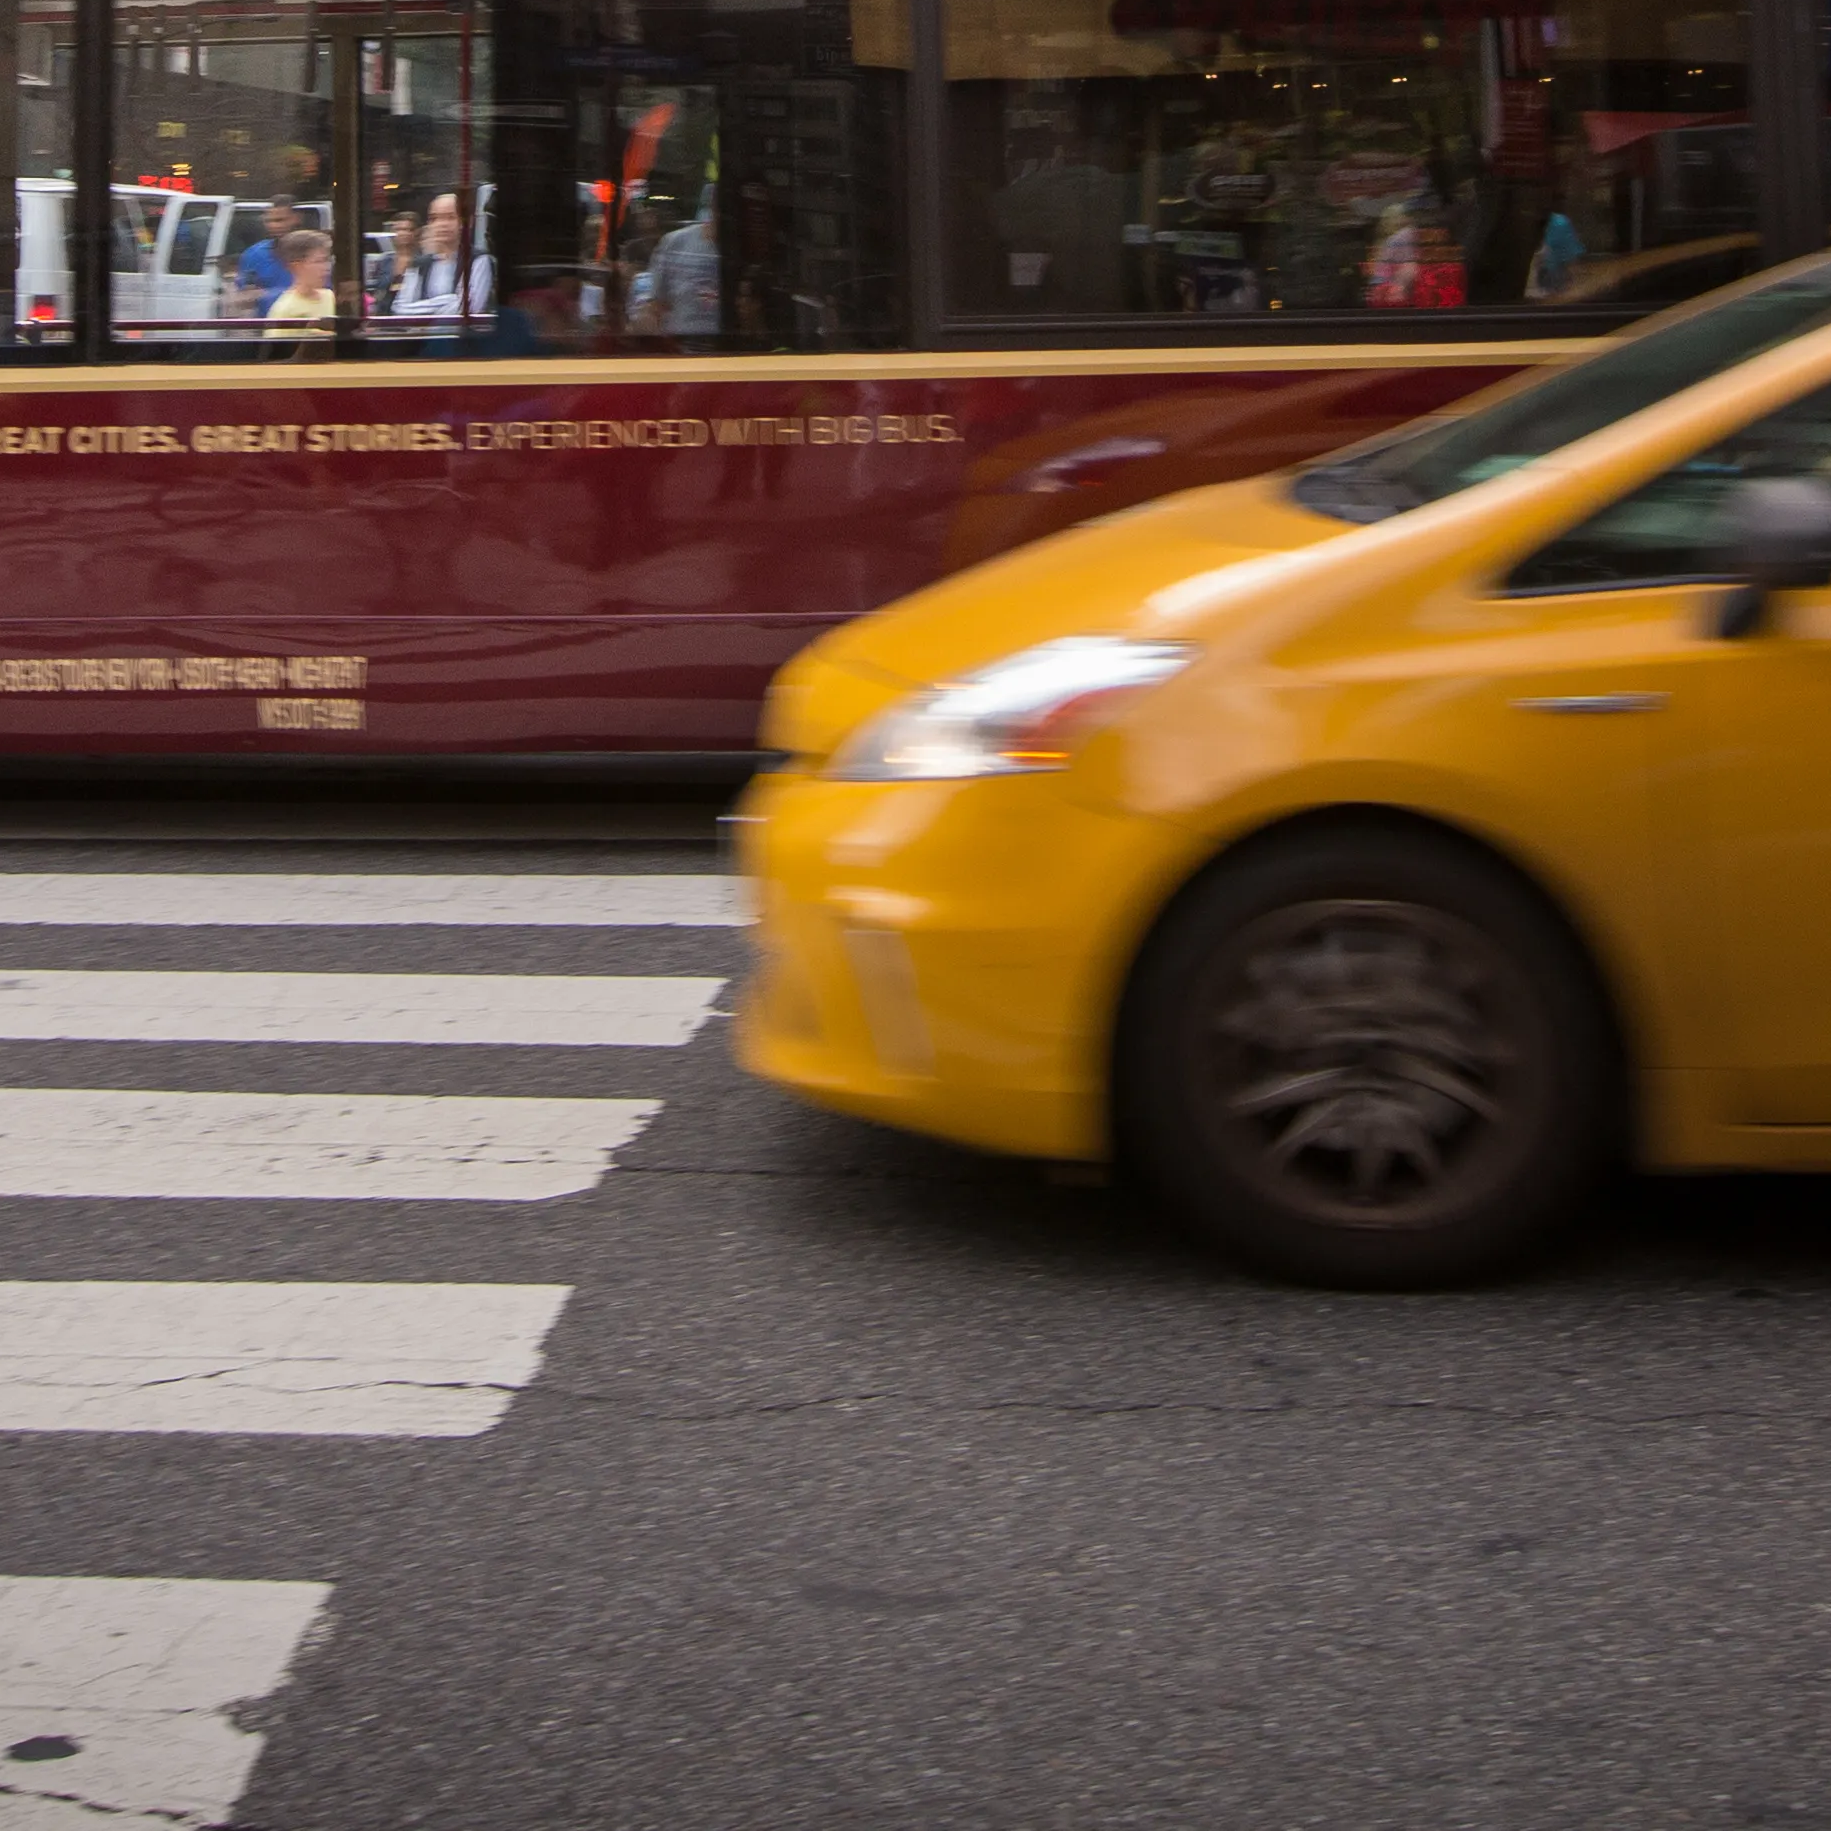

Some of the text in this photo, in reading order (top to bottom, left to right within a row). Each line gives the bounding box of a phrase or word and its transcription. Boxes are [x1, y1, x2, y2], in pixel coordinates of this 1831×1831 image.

[67, 425, 188, 454] CITIES.
[190, 423, 303, 454] GREAT
[304, 422, 463, 453] STORIES.
[466, 418, 709, 450] EXPERIENCED
[709, 416, 806, 447] WITH
[808, 415, 874, 445] BIG
